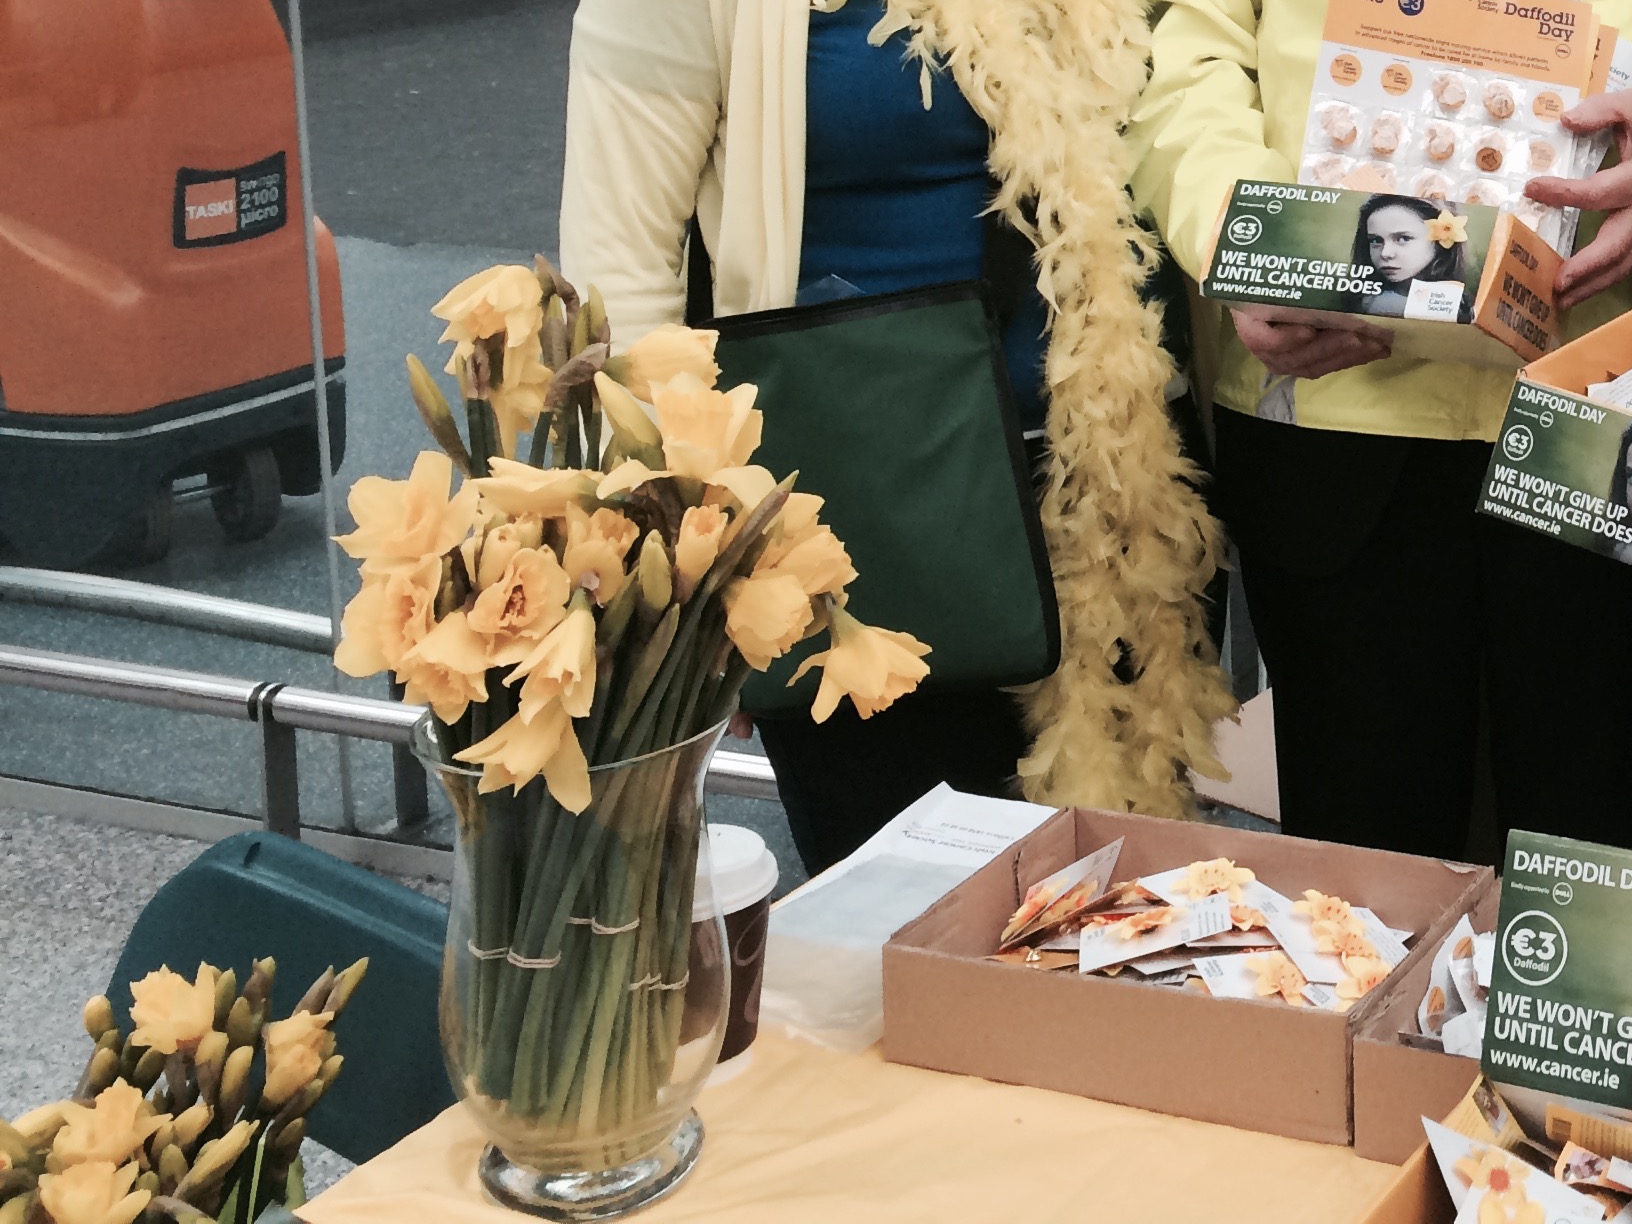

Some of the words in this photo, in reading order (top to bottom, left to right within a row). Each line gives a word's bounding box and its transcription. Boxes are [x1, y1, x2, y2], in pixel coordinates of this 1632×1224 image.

[1503, 1, 1576, 27] Daffodil
[1537, 21, 1574, 43] Day
[240, 186, 279, 210] 2100
[1240, 183, 1308, 202] DAFFODIL
[1310, 189, 1341, 204] DAY
[185, 199, 235, 220] TASKI
[1232, 222, 1257, 235] €3
[1221, 250, 1248, 266] WE
[1250, 253, 1307, 272] WON'T
[1308, 260, 1348, 277] GIVE
[1350, 265, 1374, 279] UP
[1212, 282, 1303, 300] www.cancer.ie
[1216, 264, 1265, 283] UNTIL
[1267, 270, 1334, 291] CANCER
[1336, 278, 1383, 296] DOES
[1427, 297, 1454, 307] Cancer
[1429, 290, 1446, 299] Irish
[1427, 304, 1454, 314] Society
[1517, 385, 1578, 418] DAFFODIL
[1579, 404, 1607, 425] DAY
[1507, 431, 1529, 446] €3
[1488, 480, 1532, 509] UNTIL
[1532, 495, 1591, 531] CANCER
[1494, 463, 1517, 485] WE
[1519, 471, 1570, 500] WON'T
[1569, 489, 1607, 515] GIVE
[1606, 502, 1629, 522] UP
[1483, 499, 1562, 536] www.cancer.ie
[1513, 850, 1615, 888] DAFFODIL
[1511, 927, 1558, 961] €3
[1513, 956, 1550, 973] Daffodil
[1497, 991, 1532, 1019] WE
[1537, 999, 1614, 1035] WON'T
[1493, 1016, 1559, 1051] UNTIL
[1490, 1049, 1620, 1090] www.cancer.ie
